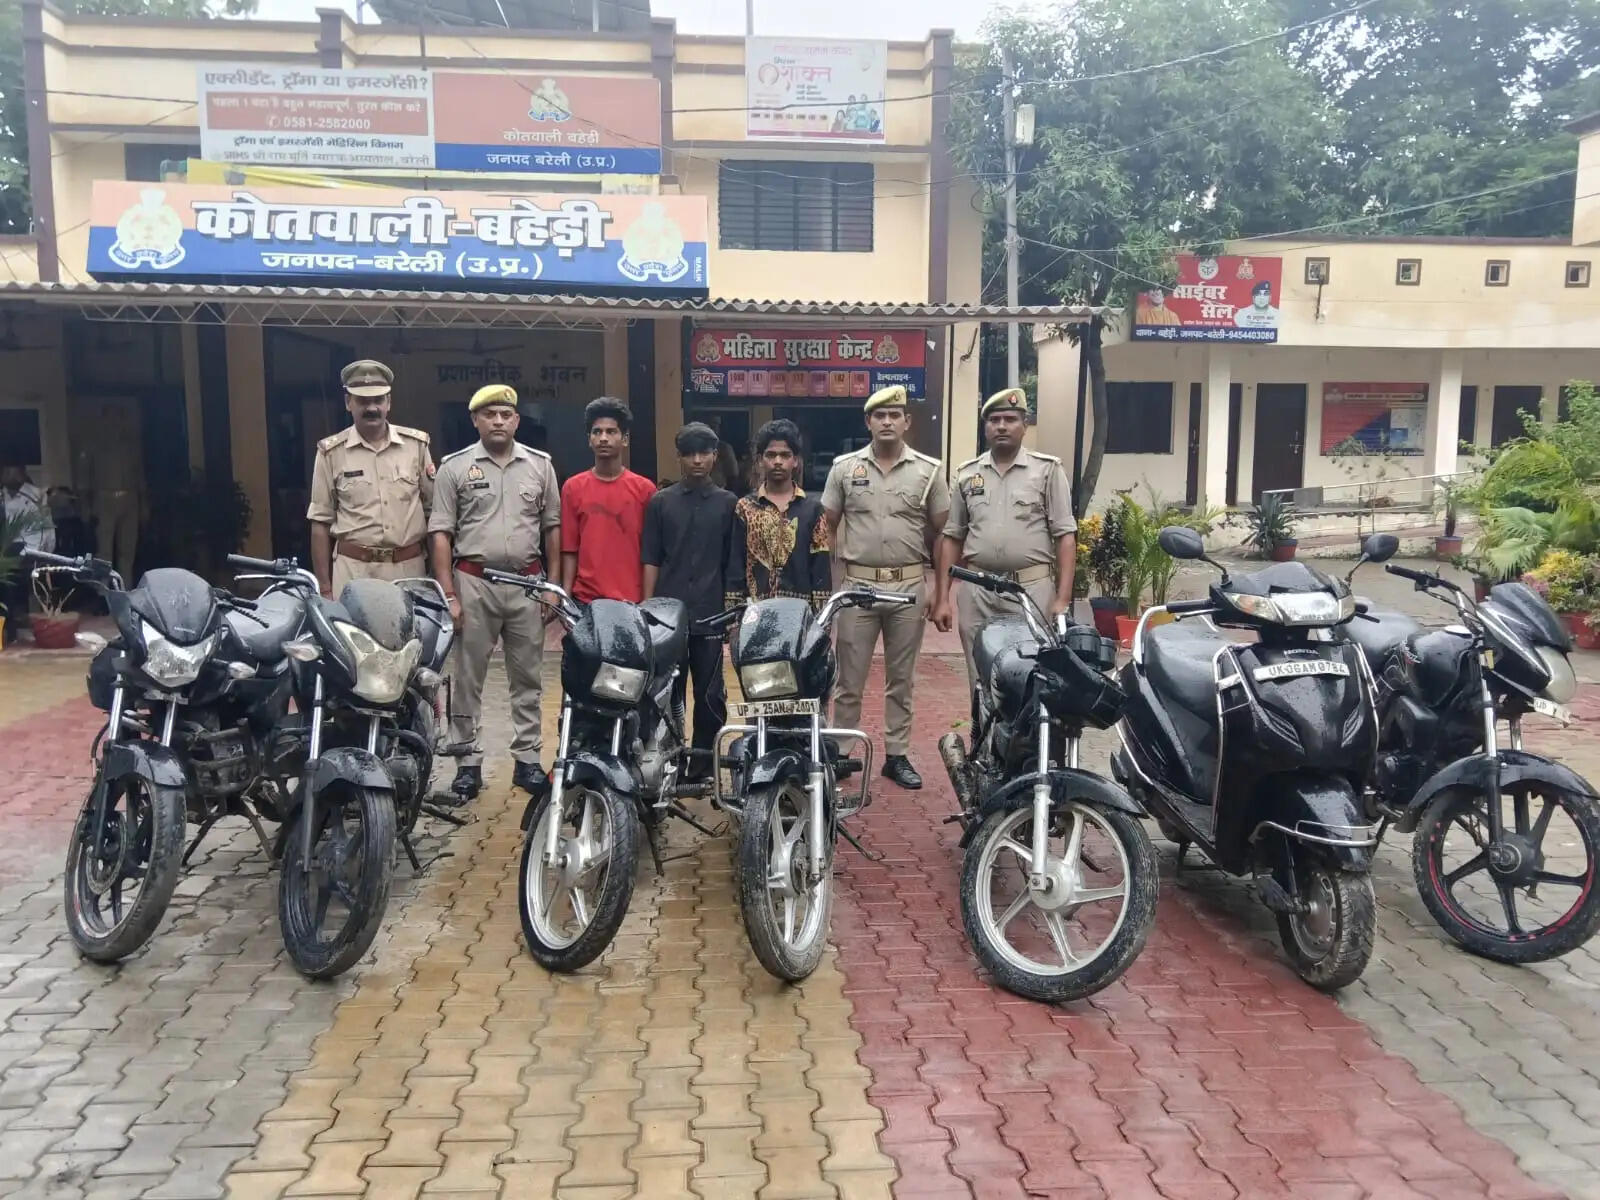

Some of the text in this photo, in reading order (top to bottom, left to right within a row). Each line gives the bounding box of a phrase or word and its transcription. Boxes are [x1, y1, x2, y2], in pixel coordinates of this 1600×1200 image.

[323, 74, 340, 87] या
[283, 117, 371, 130] 0581-2582000
[503, 127, 600, 147] कोतवाली बहेड़ी
[486, 152, 529, 167] जनपद
[534, 151, 571, 167] बरेली
[1199, 300, 1236, 319] सेल
[722, 333, 873, 366] महिला सुरक्षा केन्द्र
[737, 704, 750, 717] UP
